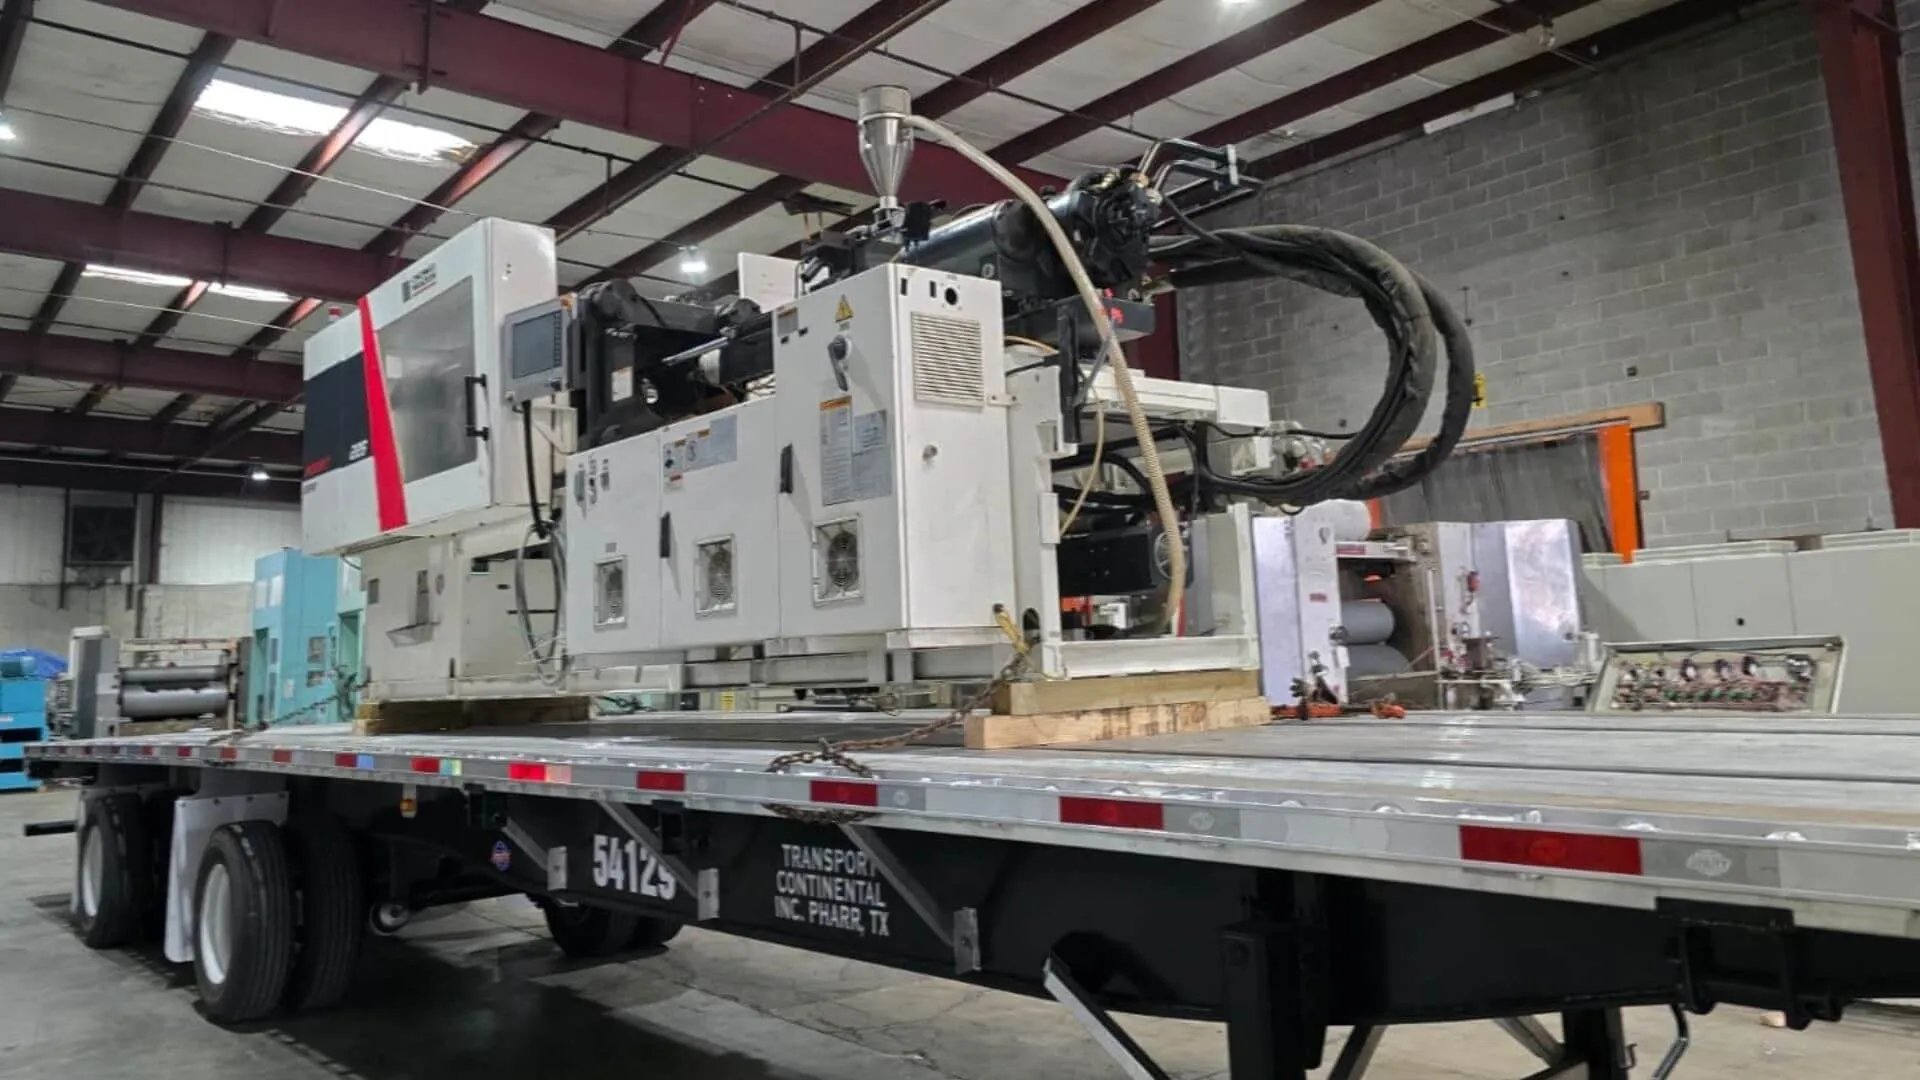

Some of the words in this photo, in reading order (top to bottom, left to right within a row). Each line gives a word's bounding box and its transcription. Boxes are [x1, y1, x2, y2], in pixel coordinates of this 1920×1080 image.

[775, 870, 887, 907] CONTINENTAL
[774, 895, 806, 921] INC.
[808, 901, 866, 937] PHARR,
[868, 909, 890, 936] TX
